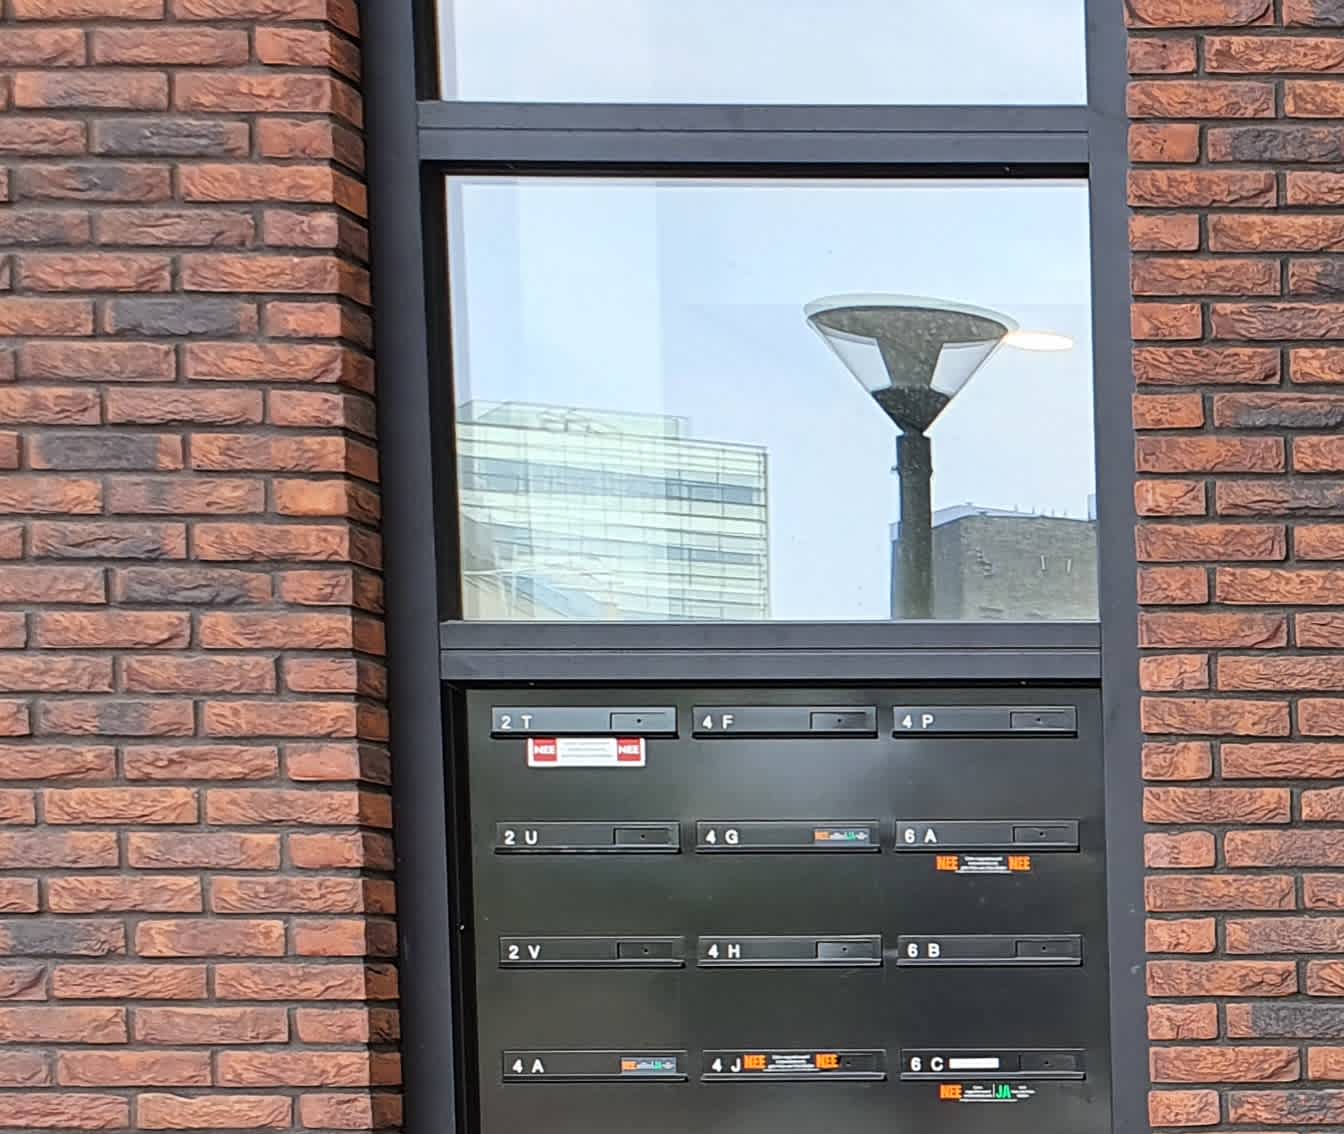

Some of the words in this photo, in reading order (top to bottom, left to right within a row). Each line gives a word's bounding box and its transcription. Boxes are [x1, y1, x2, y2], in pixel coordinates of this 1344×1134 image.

[500, 715, 511, 730] 2
[521, 715, 533, 730] T
[702, 714, 713, 730] 4
[722, 714, 734, 730] F
[902, 713, 913, 729] 4
[921, 713, 934, 729] P
[534, 745, 557, 755] NEE
[504, 829, 516, 846] 2
[524, 829, 538, 845] U
[705, 829, 717, 845] 4
[724, 828, 739, 845] G
[903, 827, 916, 844] 6
[923, 827, 938, 844] A
[936, 855, 959, 871] NEE
[1007, 855, 1031, 871] NEE
[508, 944, 520, 960] 2
[527, 944, 541, 960] V
[707, 943, 720, 959] 4
[727, 943, 741, 959] H
[907, 943, 919, 958] 6
[927, 942, 941, 958] B
[512, 1058, 524, 1074] 4
[531, 1058, 545, 1074] A
[711, 1058, 723, 1073] 4
[730, 1057, 742, 1073] J
[743, 1054, 767, 1070] NEE
[815, 1053, 840, 1069] NEE
[910, 1056, 922, 1072] 6
[930, 1056, 944, 1072] C
[939, 1084, 962, 1100] NEE
[995, 1084, 1013, 1099] JA
